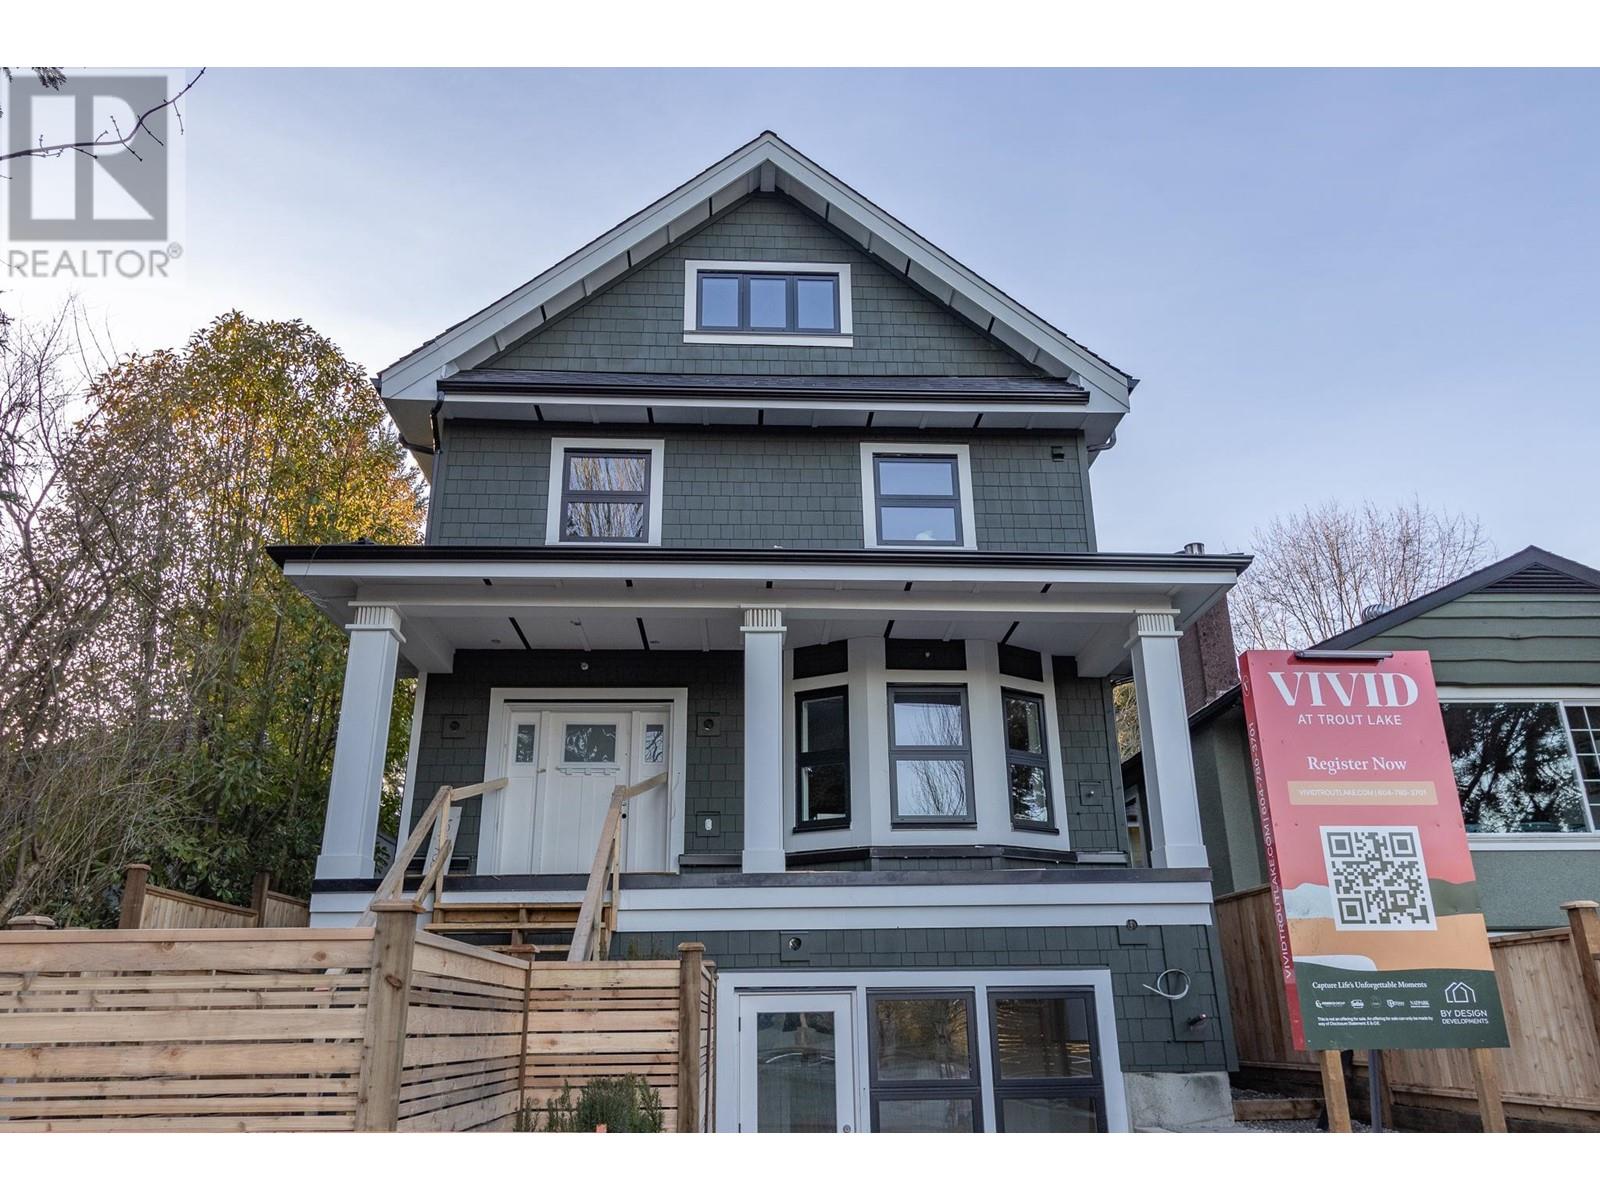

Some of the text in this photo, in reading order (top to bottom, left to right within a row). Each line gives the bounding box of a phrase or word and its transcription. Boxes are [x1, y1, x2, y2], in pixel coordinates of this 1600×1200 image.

[1267, 671, 1419, 707] VIVID
[1298, 714, 1403, 726] AT TROUT LAKE
[1306, 756, 1408, 775] Register Now
[1262, 820, 1292, 978] VIVIDTROUTLAKE.COM
[1312, 981, 1428, 990] Capture Life's Unforgettable Moments
[1440, 1009, 1488, 1017] BY DESIGN
